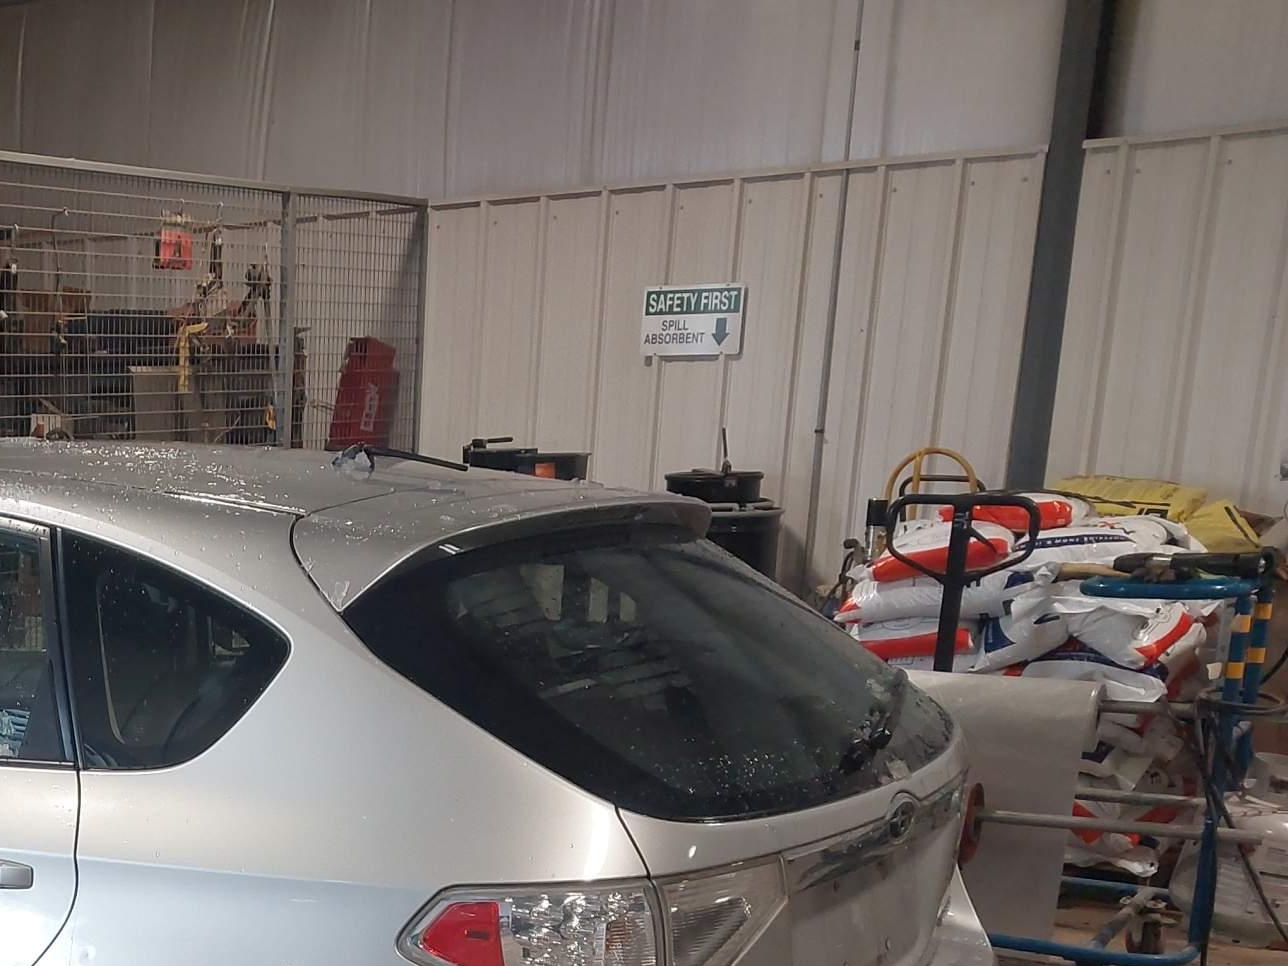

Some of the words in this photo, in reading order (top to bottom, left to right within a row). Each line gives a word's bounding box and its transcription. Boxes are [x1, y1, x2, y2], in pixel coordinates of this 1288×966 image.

[648, 292, 698, 313] SAFETY
[700, 290, 738, 311] FIRST
[661, 319, 689, 332] SPILL
[643, 332, 705, 345] ABSORBENT
